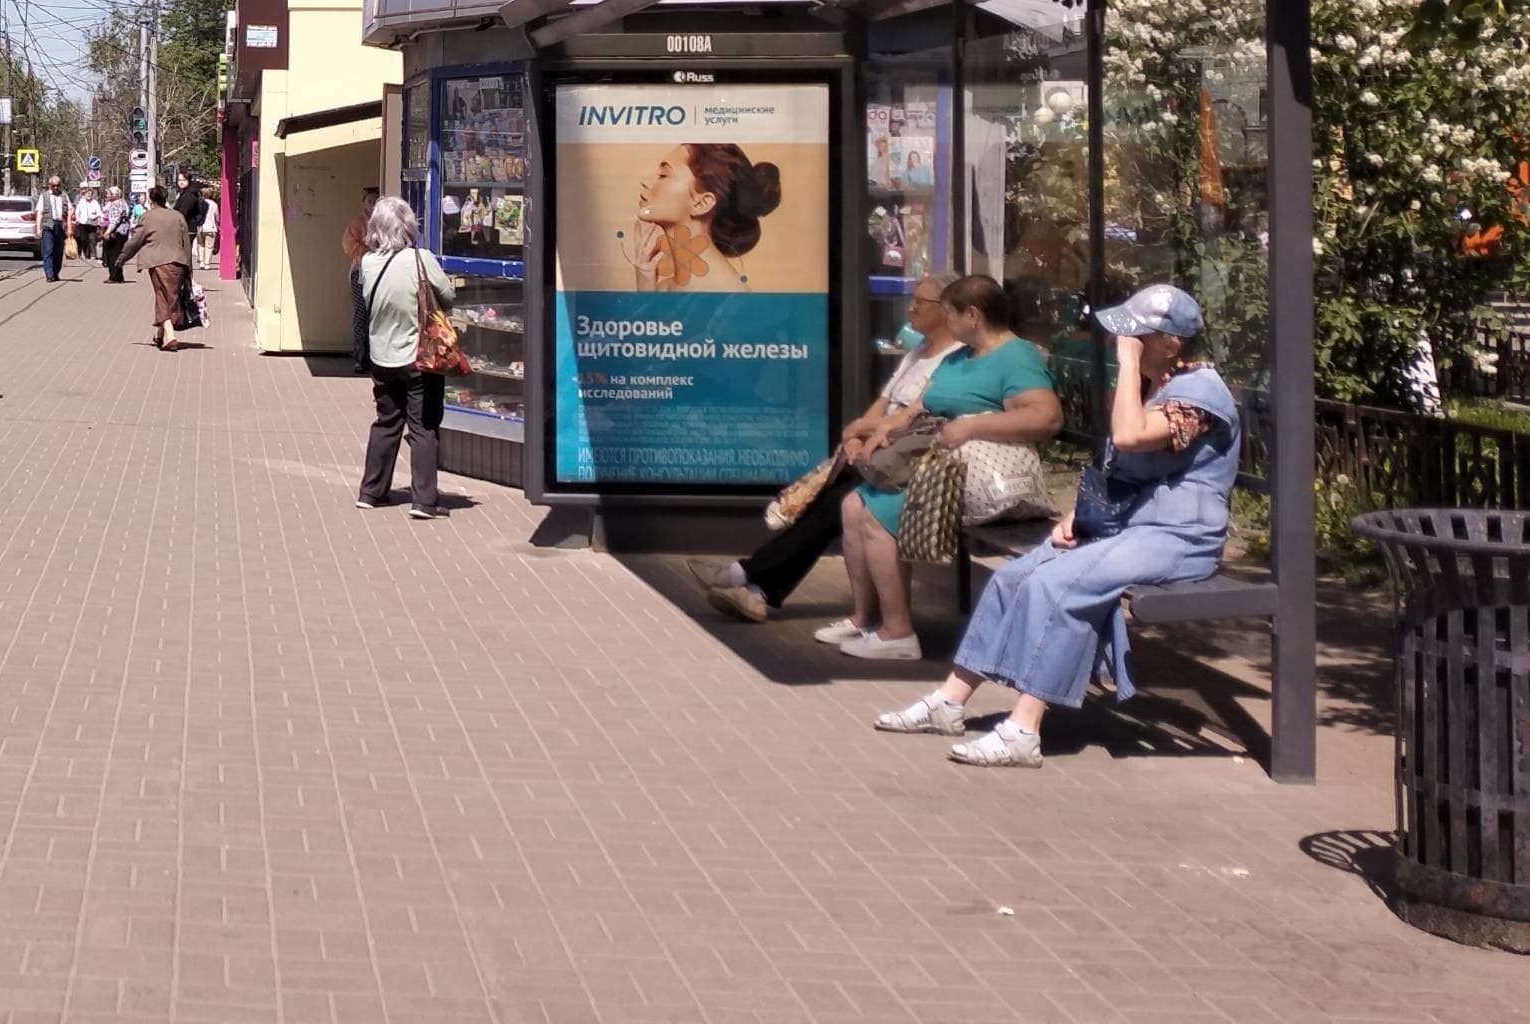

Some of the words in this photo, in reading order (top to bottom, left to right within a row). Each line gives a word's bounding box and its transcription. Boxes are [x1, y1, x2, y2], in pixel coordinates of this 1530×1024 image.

[667, 35, 712, 52] 00108A
[686, 71, 714, 82] Russ
[579, 105, 686, 125] INVITRO
[704, 106, 775, 115] медицинские
[704, 115, 739, 125] услуги
[577, 315, 684, 339] Здоровье
[577, 339, 716, 360] щитовидной
[722, 343, 808, 359] железы
[610, 375, 627, 386] на
[630, 375, 695, 387] комплекс
[578, 387, 674, 400] исследований
